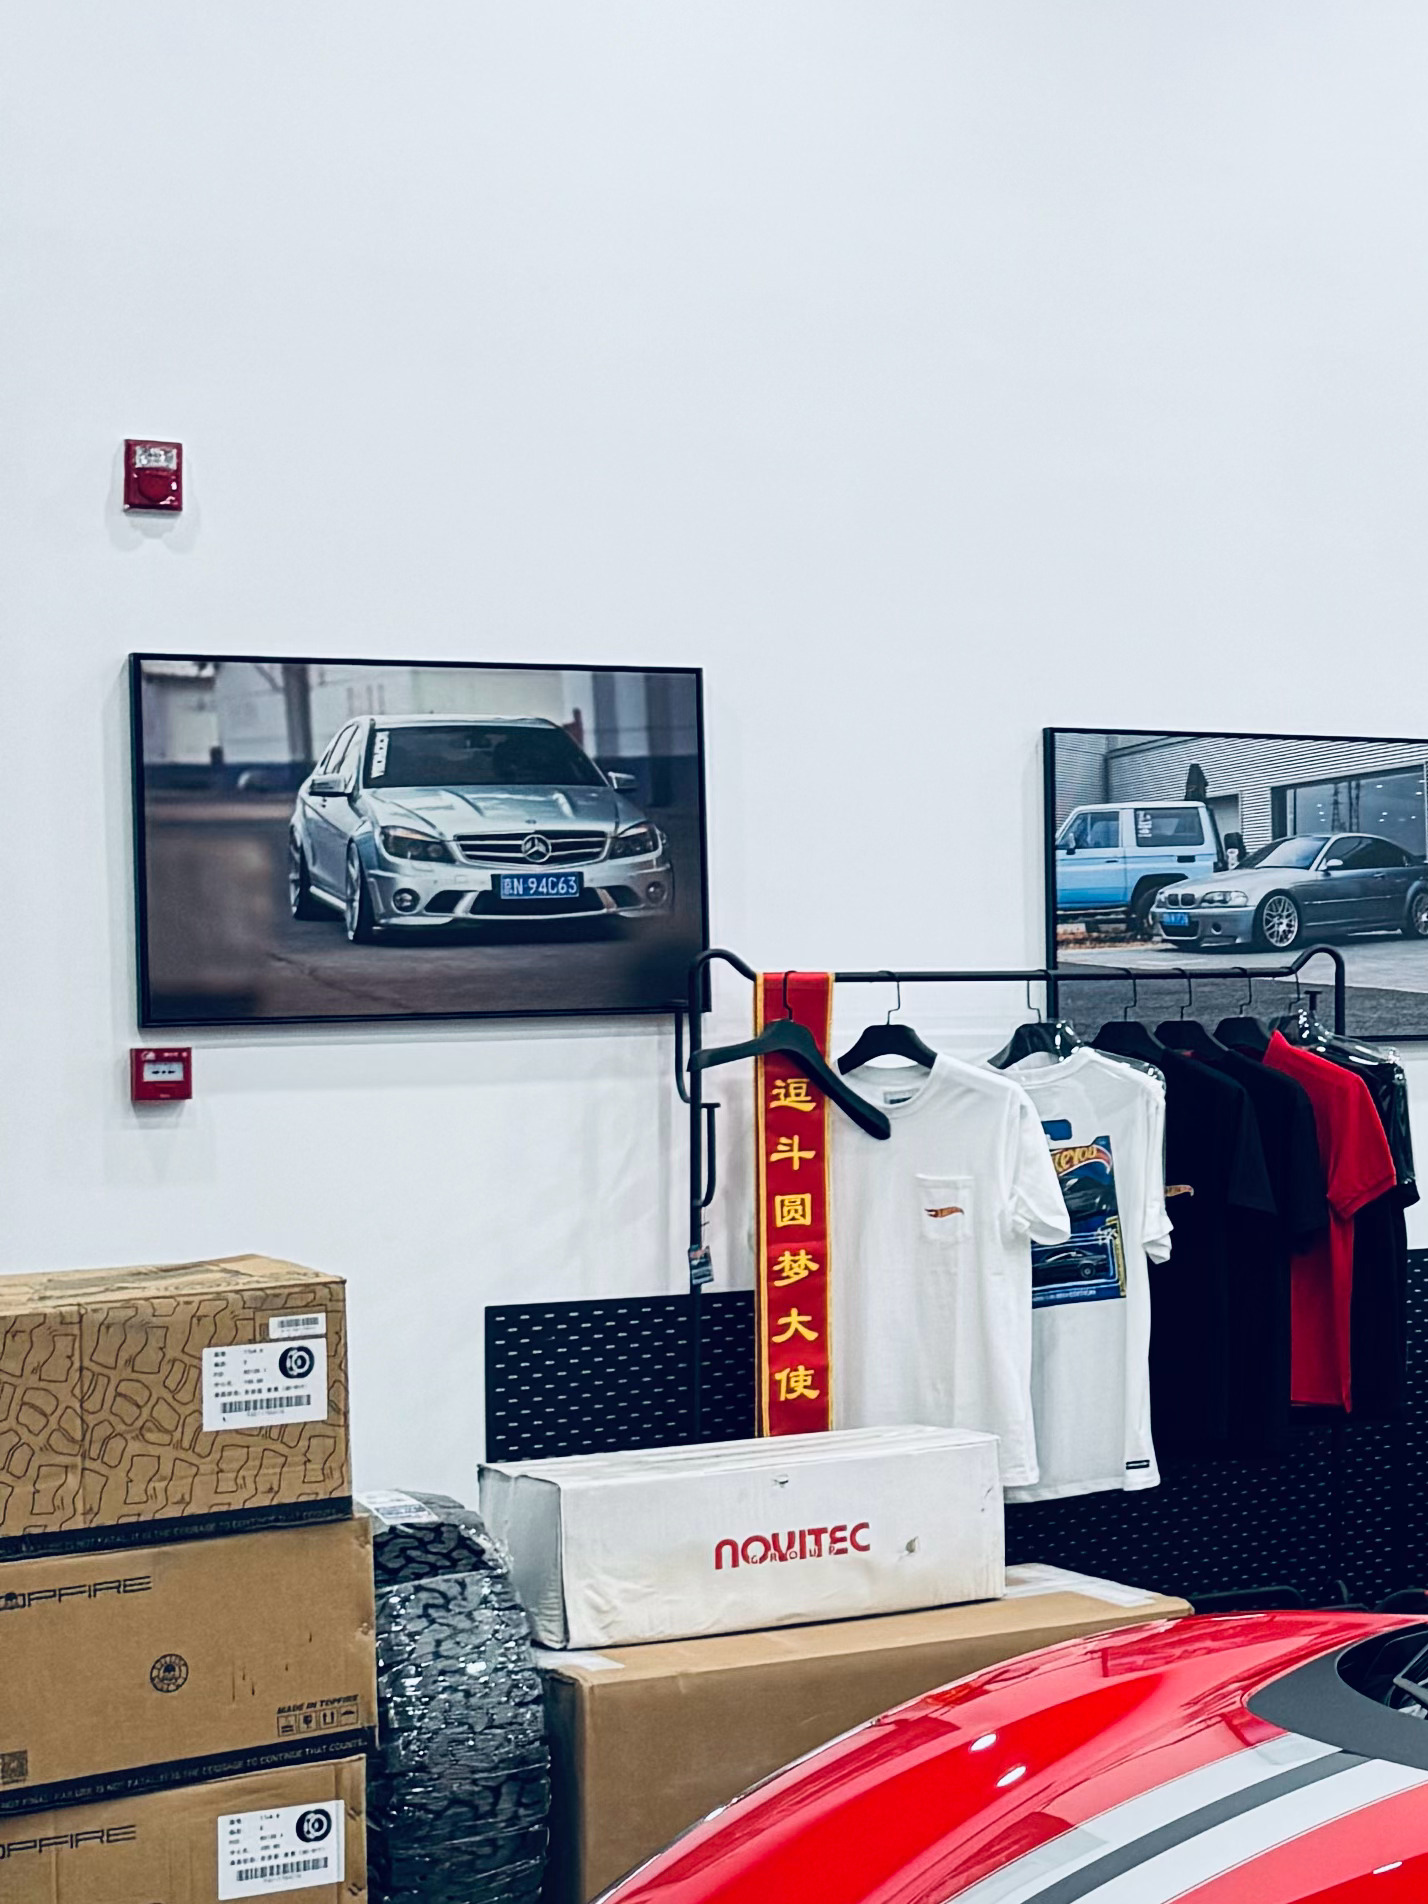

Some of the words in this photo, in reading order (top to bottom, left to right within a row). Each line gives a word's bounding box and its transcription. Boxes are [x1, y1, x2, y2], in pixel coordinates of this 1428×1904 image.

[769, 1078, 820, 1402] 逗斗圆梦大使
[715, 1522, 870, 1569] NOVITEC
